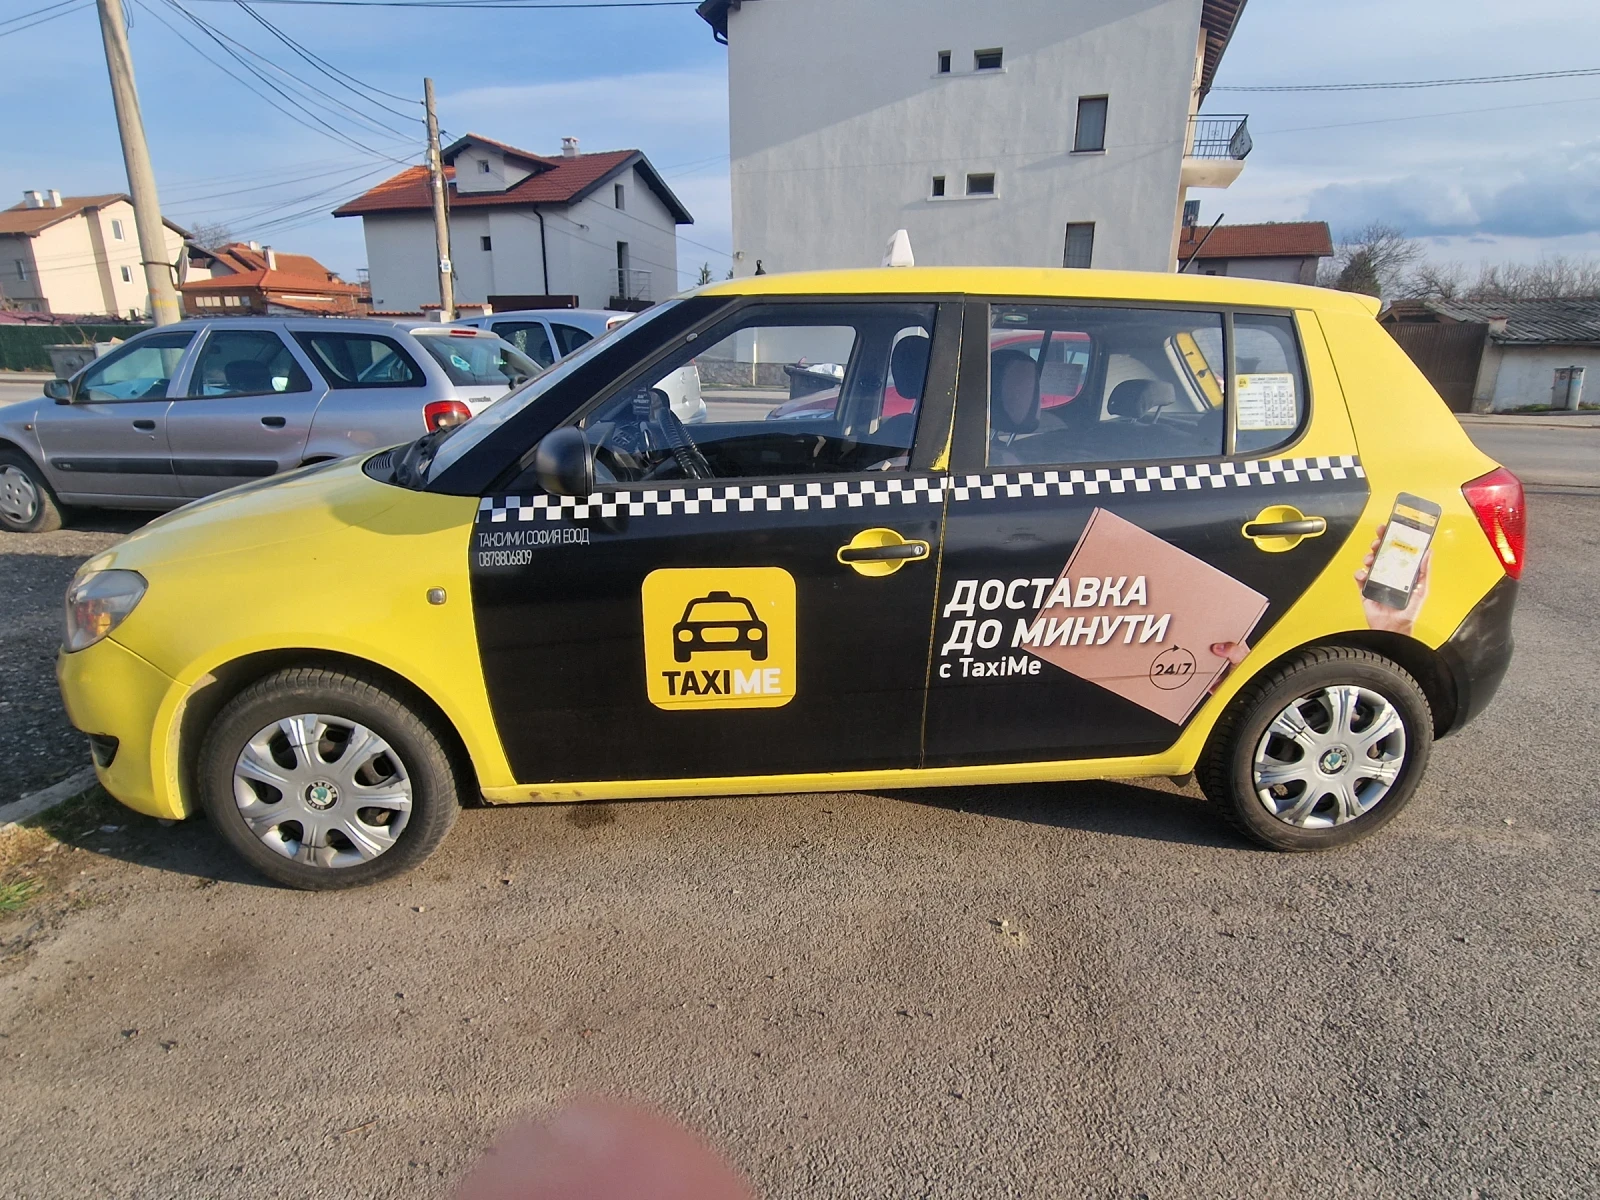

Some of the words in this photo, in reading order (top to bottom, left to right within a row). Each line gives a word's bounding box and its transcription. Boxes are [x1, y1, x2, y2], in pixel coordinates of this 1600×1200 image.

[478, 530, 525, 547] ТАКСИМИ
[526, 529, 561, 545] СОФИЯ
[563, 527, 590, 545] ЕООД
[478, 550, 533, 567] 0878806809
[942, 575, 1148, 618] ДОСТАВКА
[940, 618, 1003, 656] ДО
[1010, 613, 1172, 648] МИНУТИ
[958, 655, 1042, 678] TaxiMe
[1154, 662, 1193, 676] 24/7
